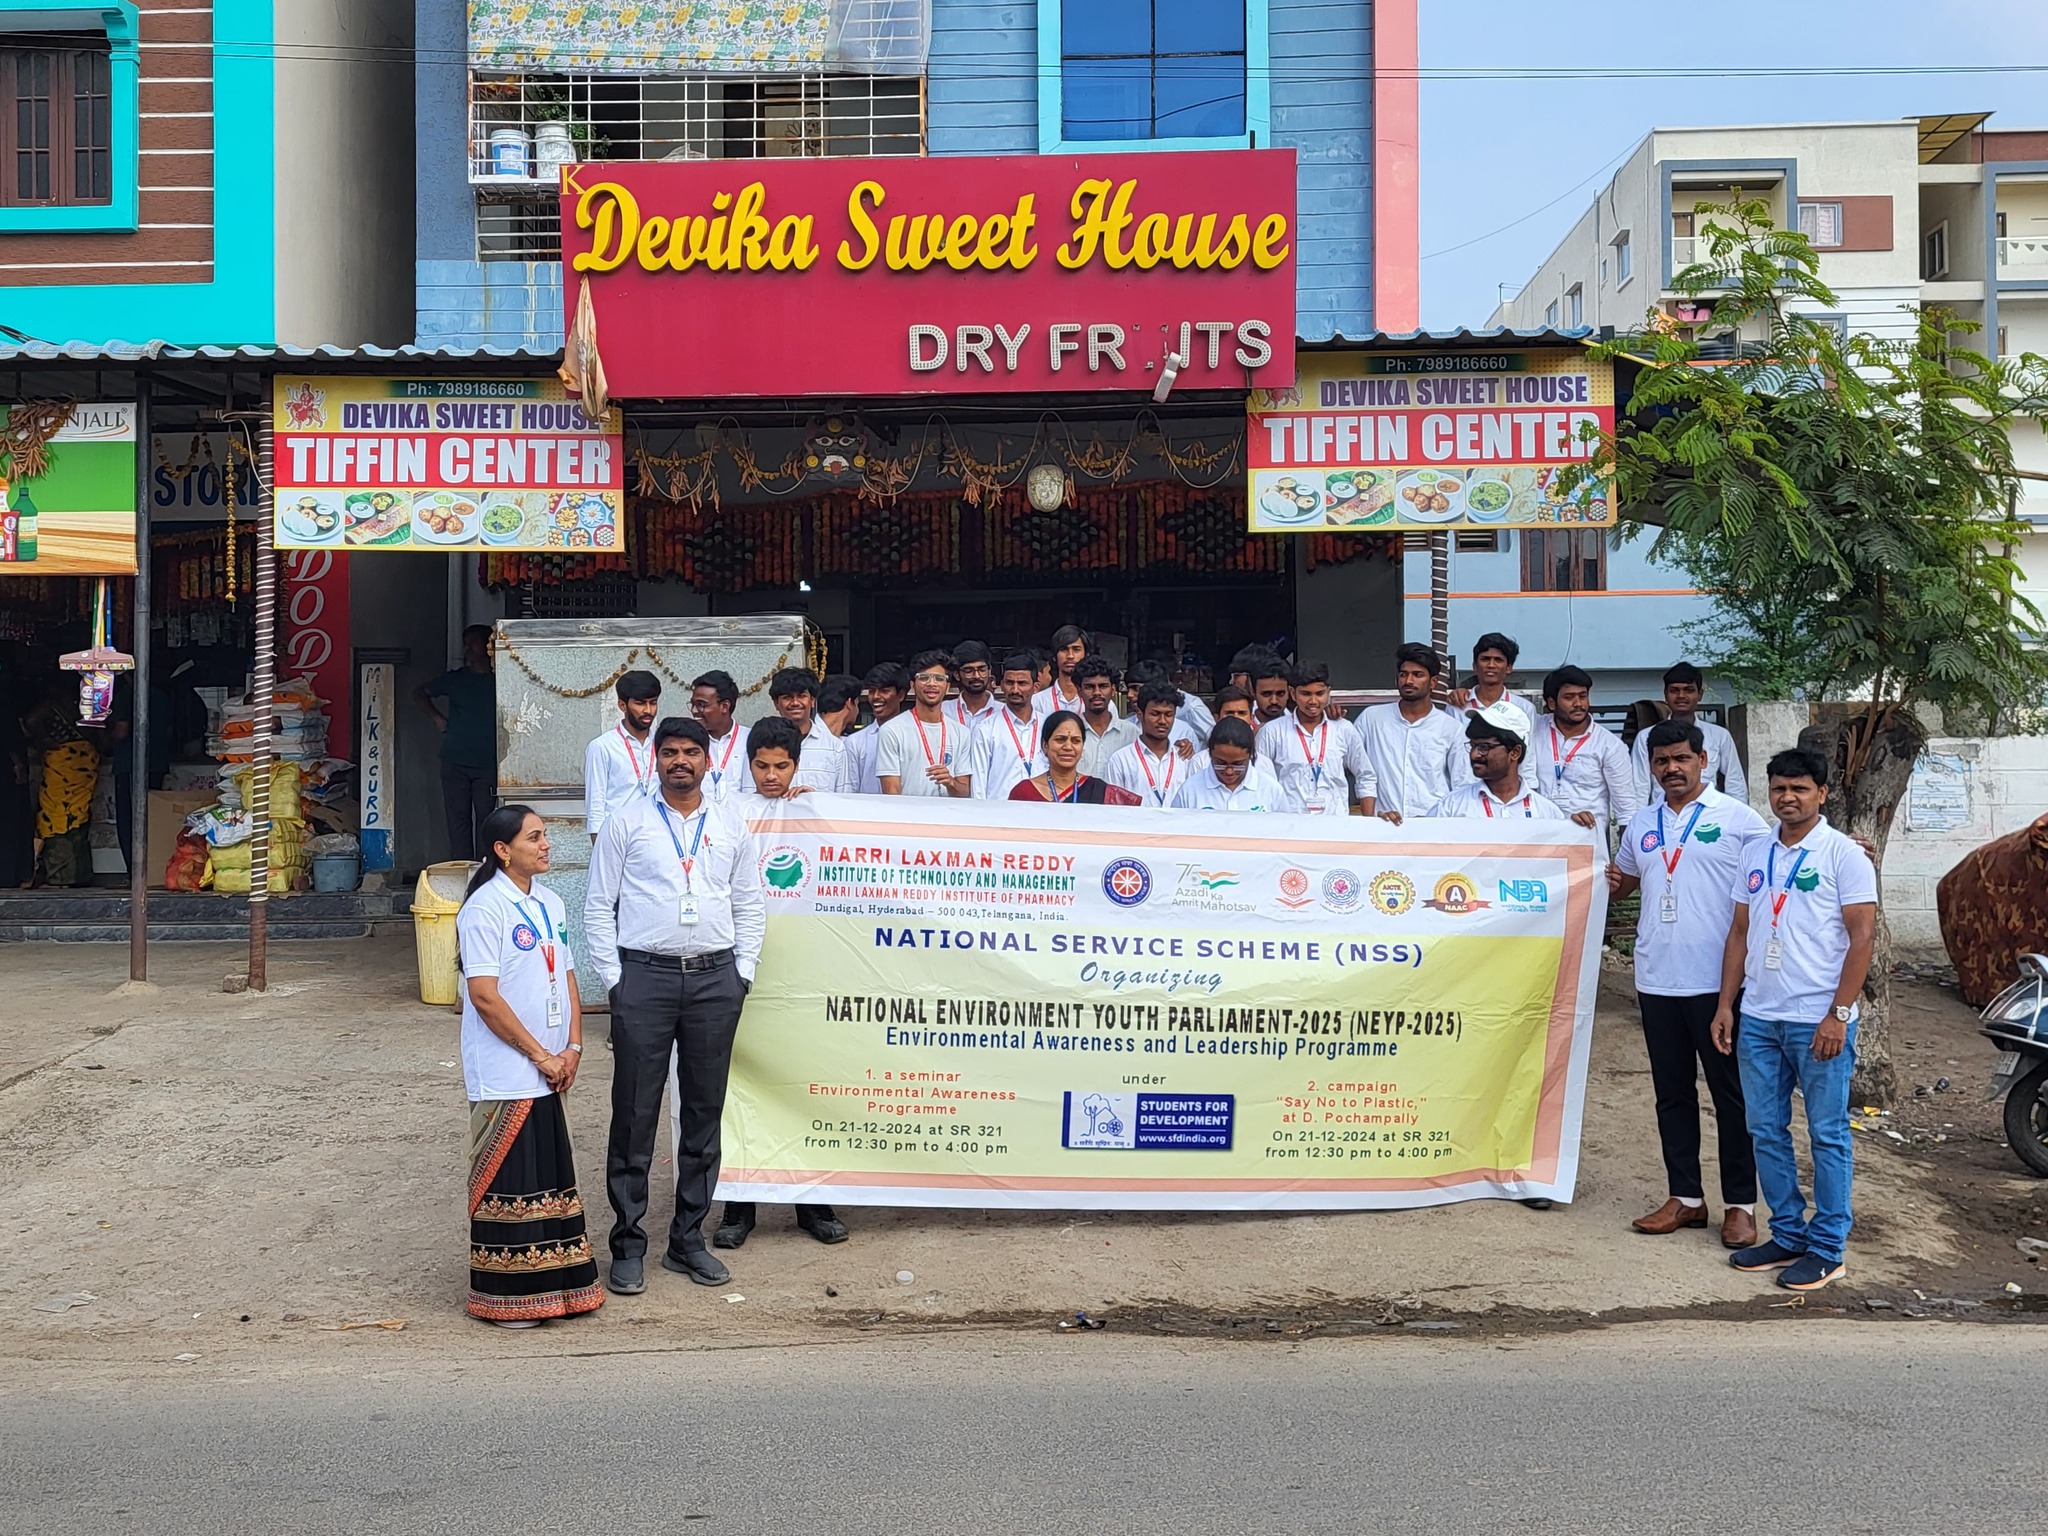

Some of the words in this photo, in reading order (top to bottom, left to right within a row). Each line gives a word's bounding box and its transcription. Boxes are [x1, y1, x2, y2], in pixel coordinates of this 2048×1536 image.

[561, 165, 586, 195] K
[573, 181, 819, 273] Devika
[837, 180, 1038, 271] Sweet
[1058, 178, 1289, 269] House
[909, 324, 1031, 372] DRY
[1051, 319, 1272, 370] FRITS
[1386, 358, 1411, 371] Ph:
[1417, 356, 1507, 371] 7989186660
[408, 383, 432, 396] Ph:
[437, 382, 524, 396] 7989186660
[1321, 379, 1409, 407] DEVIKA
[1417, 377, 1499, 404] SWEET
[1506, 376, 1588, 403] HOUSE
[343, 403, 430, 430] DEVIKA
[436, 403, 516, 430] SWEET
[1263, 415, 1408, 463] TIFFIN
[1422, 412, 1600, 461] CENTER
[286, 438, 427, 483] TIFFIN
[439, 438, 611, 484] CENTER
[366, 764, 380, 826] CURD
[820, 846, 890, 864] MARRI
[902, 849, 992, 868] LAXMAN
[1004, 854, 1076, 872] REDDY
[819, 866, 877, 882] INSTITUTE
[882, 868, 894, 883] OF
[899, 869, 972, 886] TECHNOLOGY
[976, 872, 997, 888] AND
[1002, 873, 1076, 891] MANAGEMENT
[817, 885, 850, 897] MARRI
[855, 886, 898, 898] LAXMAN
[903, 888, 937, 900] REDDY
[941, 890, 996, 903] INSTITUTE
[1001, 893, 1013, 903] OF
[1018, 893, 1074, 906] PHARMACY
[1176, 887, 1208, 897] Azadi
[1450, 887, 1463, 902] A
[1499, 879, 1547, 902] NBA
[815, 903, 864, 915] Dundigal,
[868, 904, 924, 916] Hyderabad
[938, 907, 956, 916] 500
[1171, 898, 1199, 908] Amrit
[1200, 901, 1256, 912] Mahotsav
[875, 928, 1037, 951] NATIONAL
[1052, 935, 1183, 956] SERVICE
[1197, 940, 1320, 960] SCHEME
[1335, 942, 1422, 967] (NSS)
[1080, 962, 1222, 992] Organizing
[826, 996, 927, 1024] NATIONAL
[936, 999, 1083, 1028] ENVIRONMENT
[1092, 1004, 1158, 1031] YOUTH
[1168, 1006, 1342, 1034] PARLIAMENT-2025
[1350, 1010, 1462, 1042] (NEYP-2025)
[886, 1026, 1025, 1049] Environmental
[1032, 1031, 1134, 1052] Awareness
[1144, 1036, 1176, 1053] and
[1186, 1036, 1288, 1060] Leadership
[1296, 1038, 1398, 1060] Programme
[866, 1069, 876, 1080] 1.
[885, 1072, 892, 1080] a
[900, 1071, 961, 1082] seminar
[1122, 1074, 1167, 1084] under
[809, 1084, 924, 1098] Environmental
[931, 1088, 1016, 1100] Awareness
[1308, 1081, 1319, 1092] 2.
[1328, 1081, 1397, 1094] campaign
[868, 1102, 957, 1115] Programme
[1141, 1101, 1202, 1111] STUDENTS
[1206, 1102, 1228, 1111] FOR
[1277, 1096, 1310, 1109] "Say
[1317, 1097, 1336, 1108] No
[1343, 1098, 1357, 1107] to
[1140, 1115, 1228, 1126] DEVELOPMENT
[1283, 1113, 1296, 1123] at
[1303, 1112, 1317, 1123] D.
[1325, 1112, 1418, 1125] Pochampally
[812, 1120, 833, 1131] On
[839, 1121, 921, 1135] 21-12-2024
[929, 1125, 943, 1135] at
[950, 1125, 970, 1136] SR
[978, 1126, 1002, 1136] 321
[1273, 1130, 1292, 1141] On
[1300, 1131, 1376, 1142] 21-12-2024
[1383, 1132, 1396, 1141] at
[1403, 1131, 1421, 1141] SR
[1428, 1131, 1450, 1141] 321
[805, 1136, 839, 1148] from
[847, 1138, 887, 1150] 12:30
[895, 1142, 916, 1153] pm
[924, 1141, 939, 1152] to
[946, 1142, 978, 1153] 4:00
[986, 1144, 1007, 1155] pm
[1139, 1133, 1226, 1144] www.sfdindia.org
[1266, 1147, 1299, 1157] from
[1305, 1147, 1343, 1157] 12:30
[1350, 1149, 1371, 1160] pm
[1378, 1148, 1391, 1157] to
[1398, 1147, 1428, 1157] 4:00
[1434, 1147, 1452, 1159] pm
